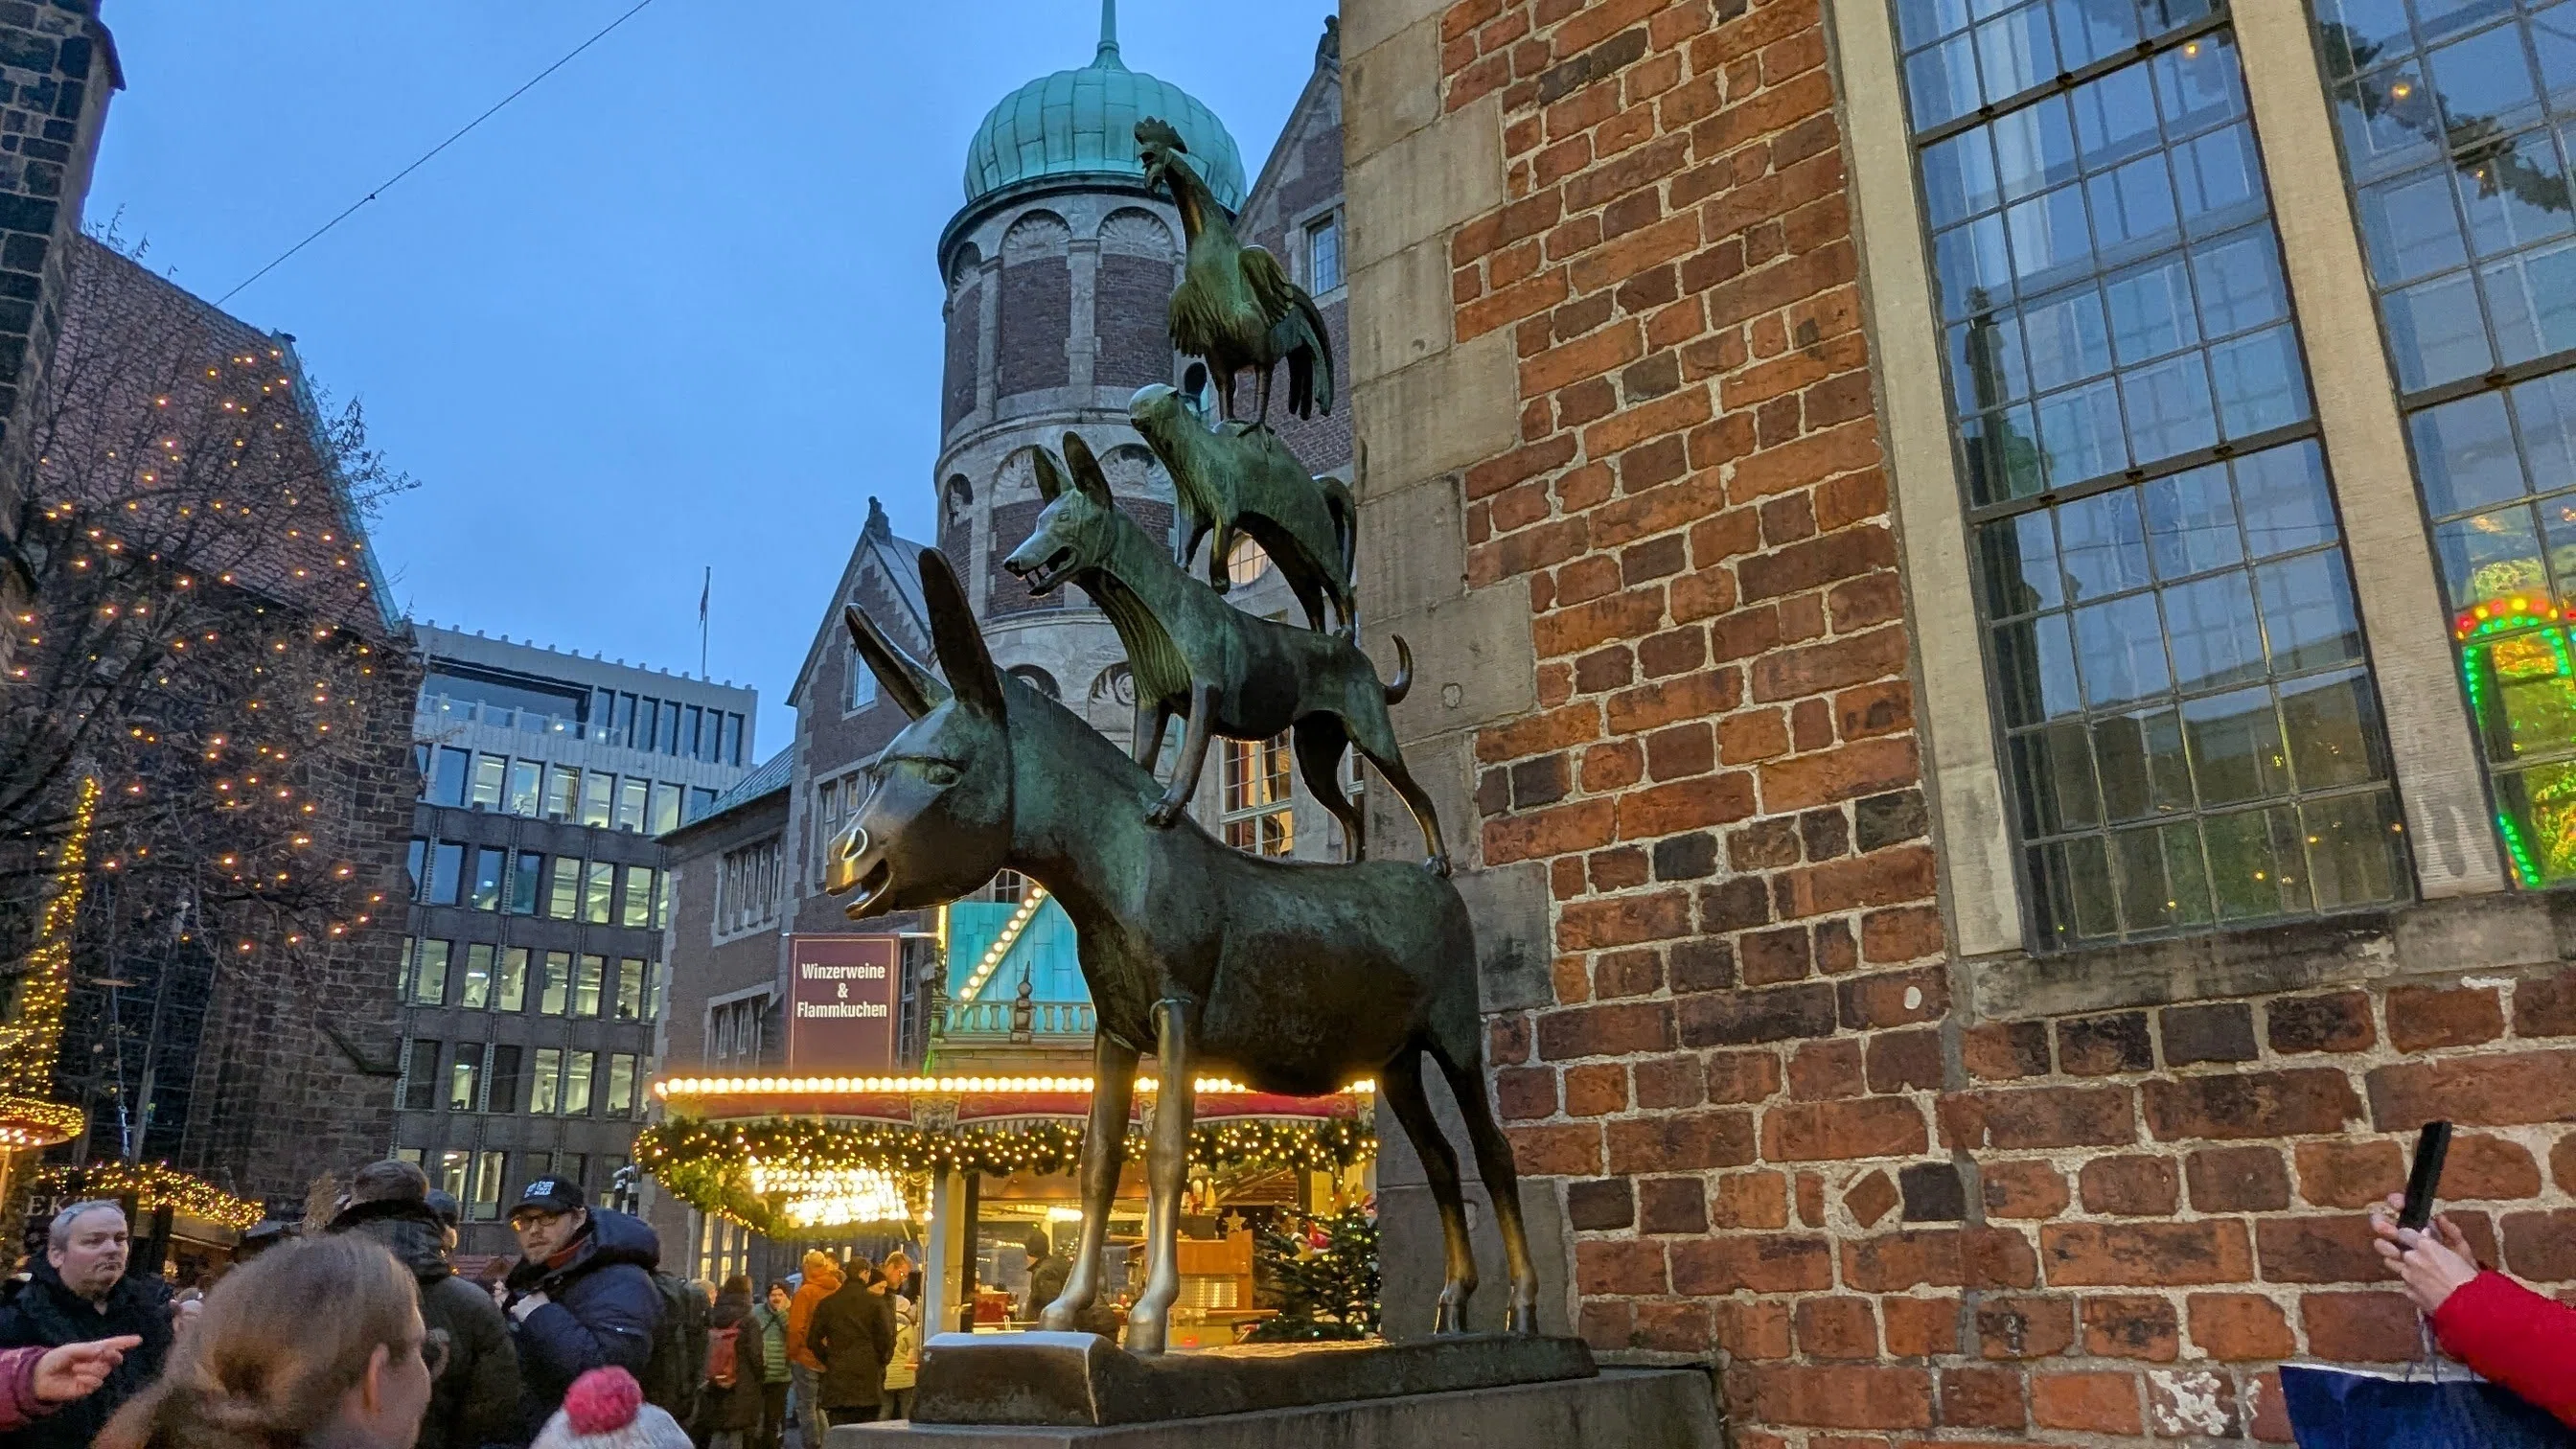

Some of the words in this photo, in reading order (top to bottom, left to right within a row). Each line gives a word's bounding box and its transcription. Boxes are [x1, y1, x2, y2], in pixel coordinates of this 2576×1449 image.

[801, 963, 886, 979] Winzerweine
[837, 982, 849, 999] &
[796, 1001, 887, 1018] Flammkuchen
